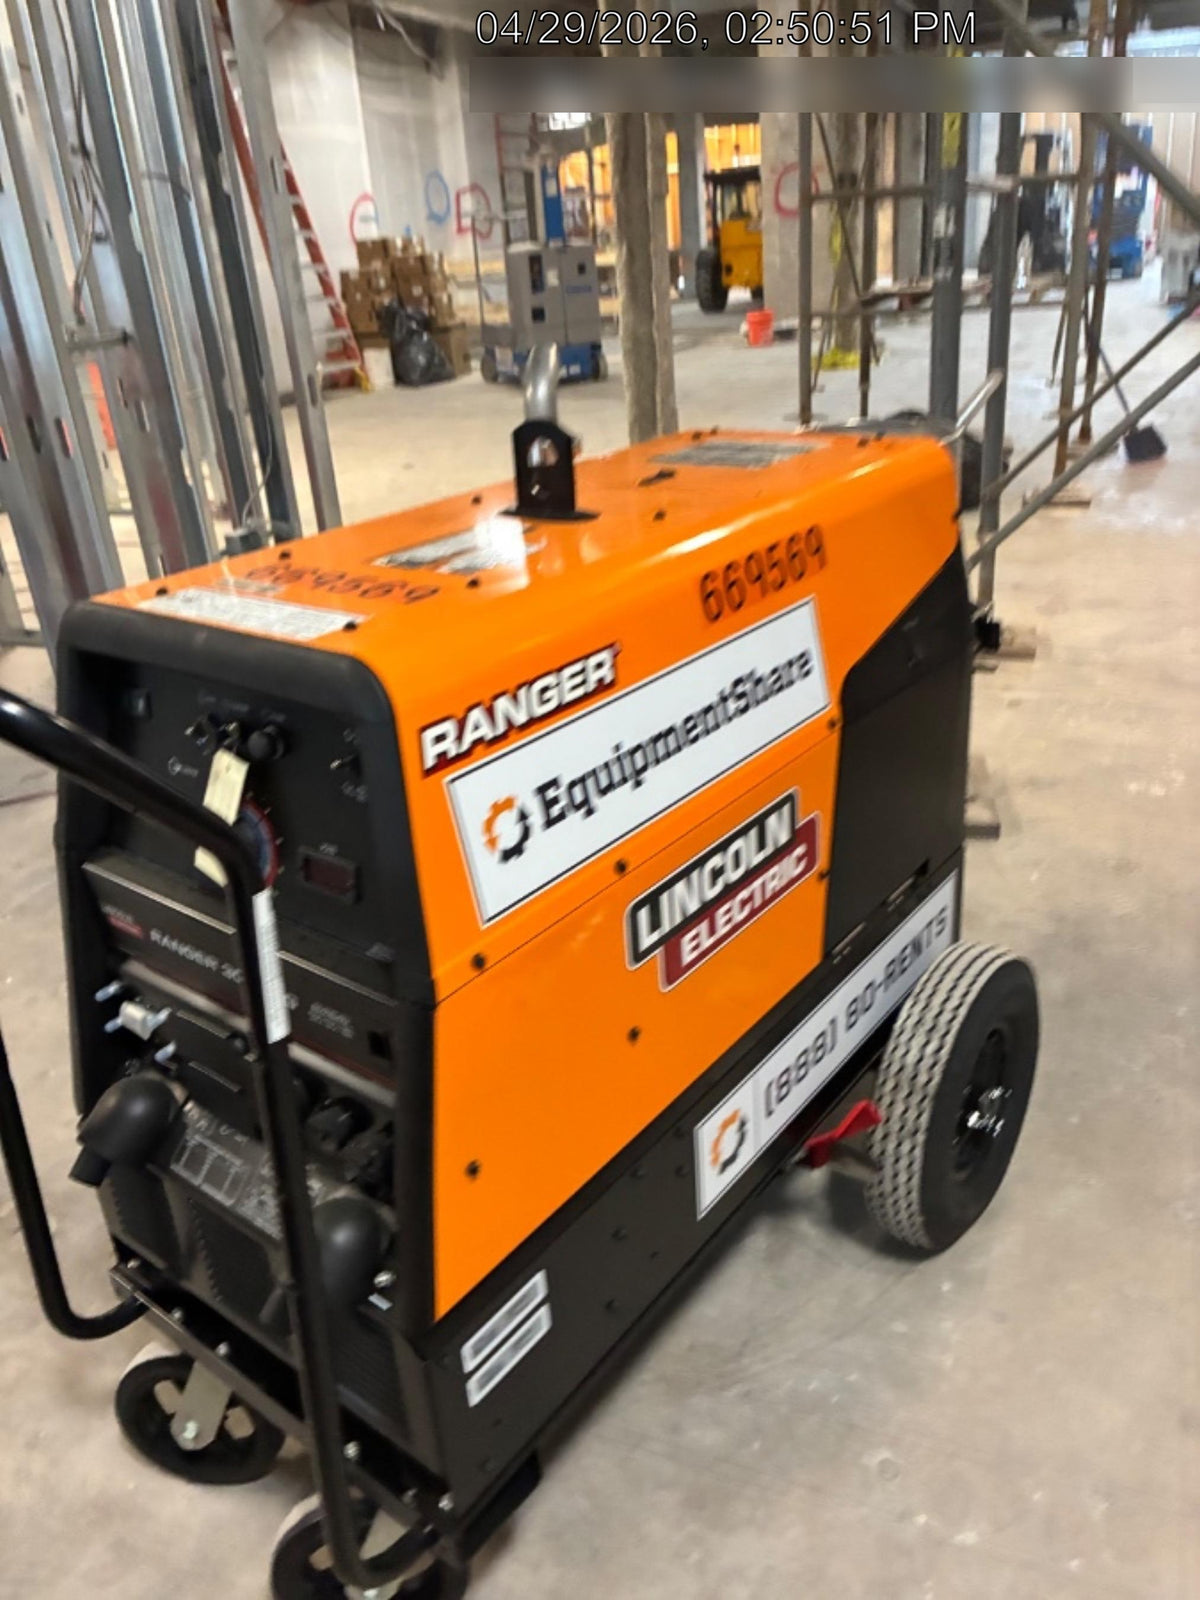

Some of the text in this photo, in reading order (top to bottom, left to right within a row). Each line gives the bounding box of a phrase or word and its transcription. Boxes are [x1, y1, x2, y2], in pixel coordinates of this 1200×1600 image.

[700, 525, 827, 623] 669569
[420, 646, 616, 771] RANGER
[535, 648, 813, 830] EquipmentShare
[636, 801, 793, 954] LINCOLN
[680, 843, 808, 967] ELECTRIC
[150, 927, 220, 972] RANGER
[764, 904, 948, 1119] (888) 80-RENTS
